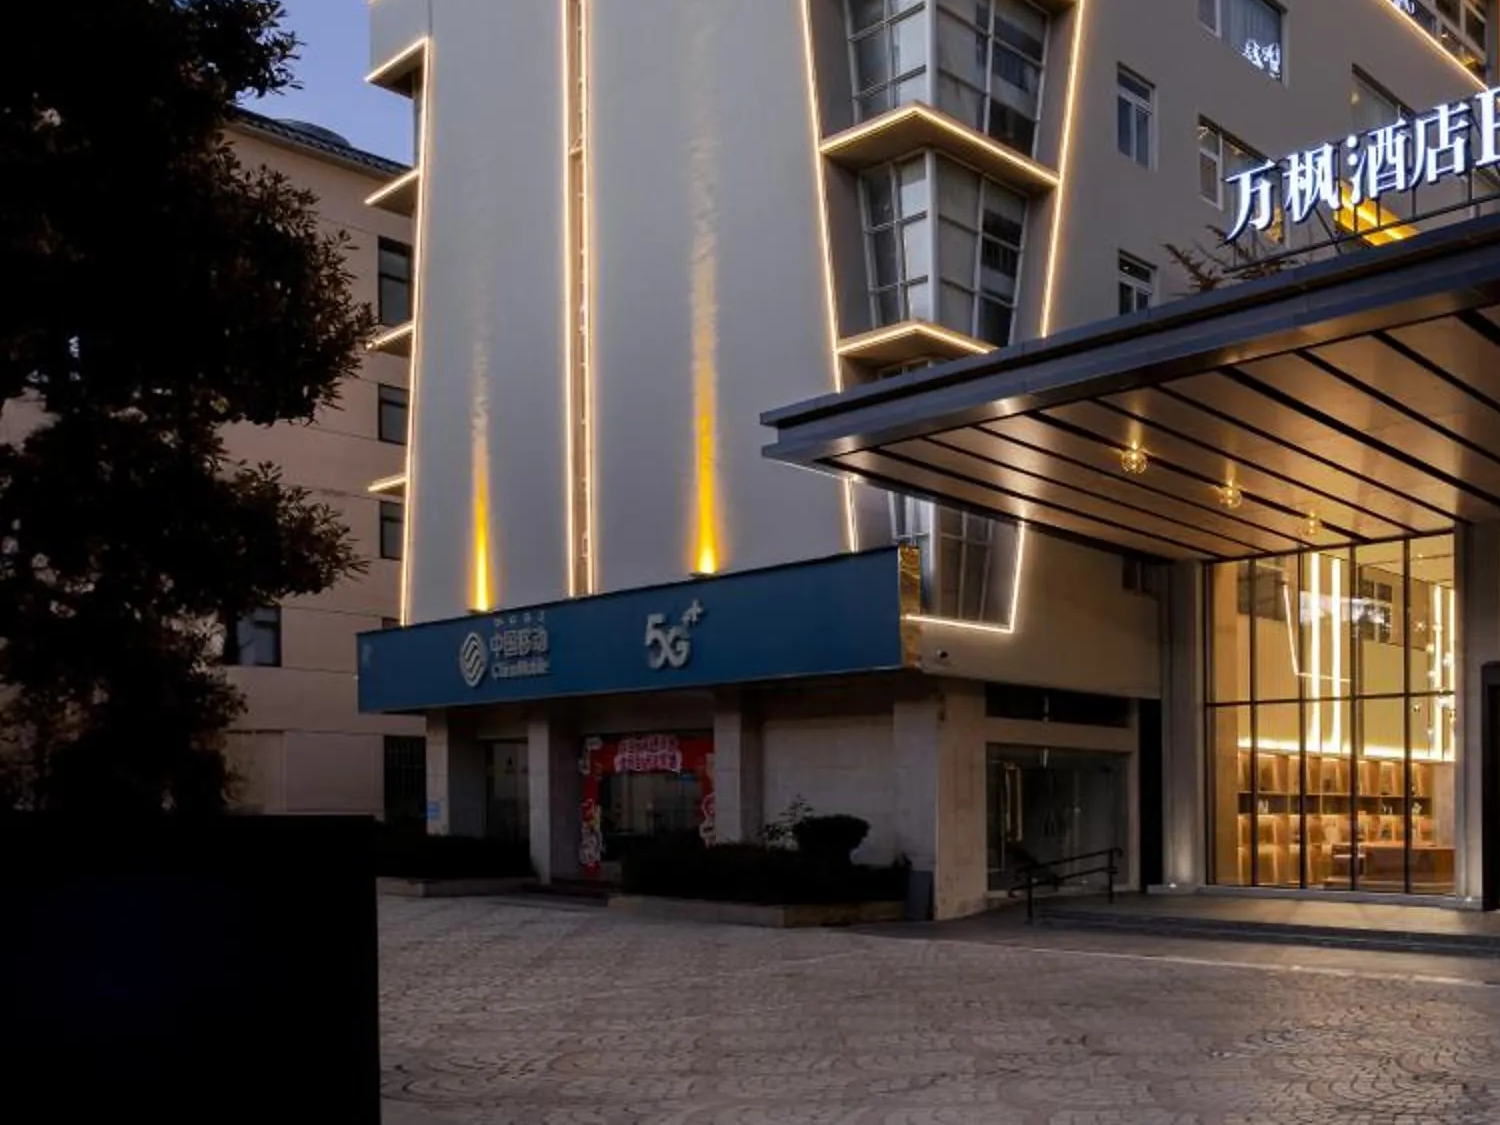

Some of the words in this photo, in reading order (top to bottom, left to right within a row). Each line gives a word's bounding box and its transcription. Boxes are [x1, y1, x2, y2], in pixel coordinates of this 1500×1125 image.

[1225, 101, 1474, 244] 万枫酒店
[490, 626, 548, 660] 中国移动
